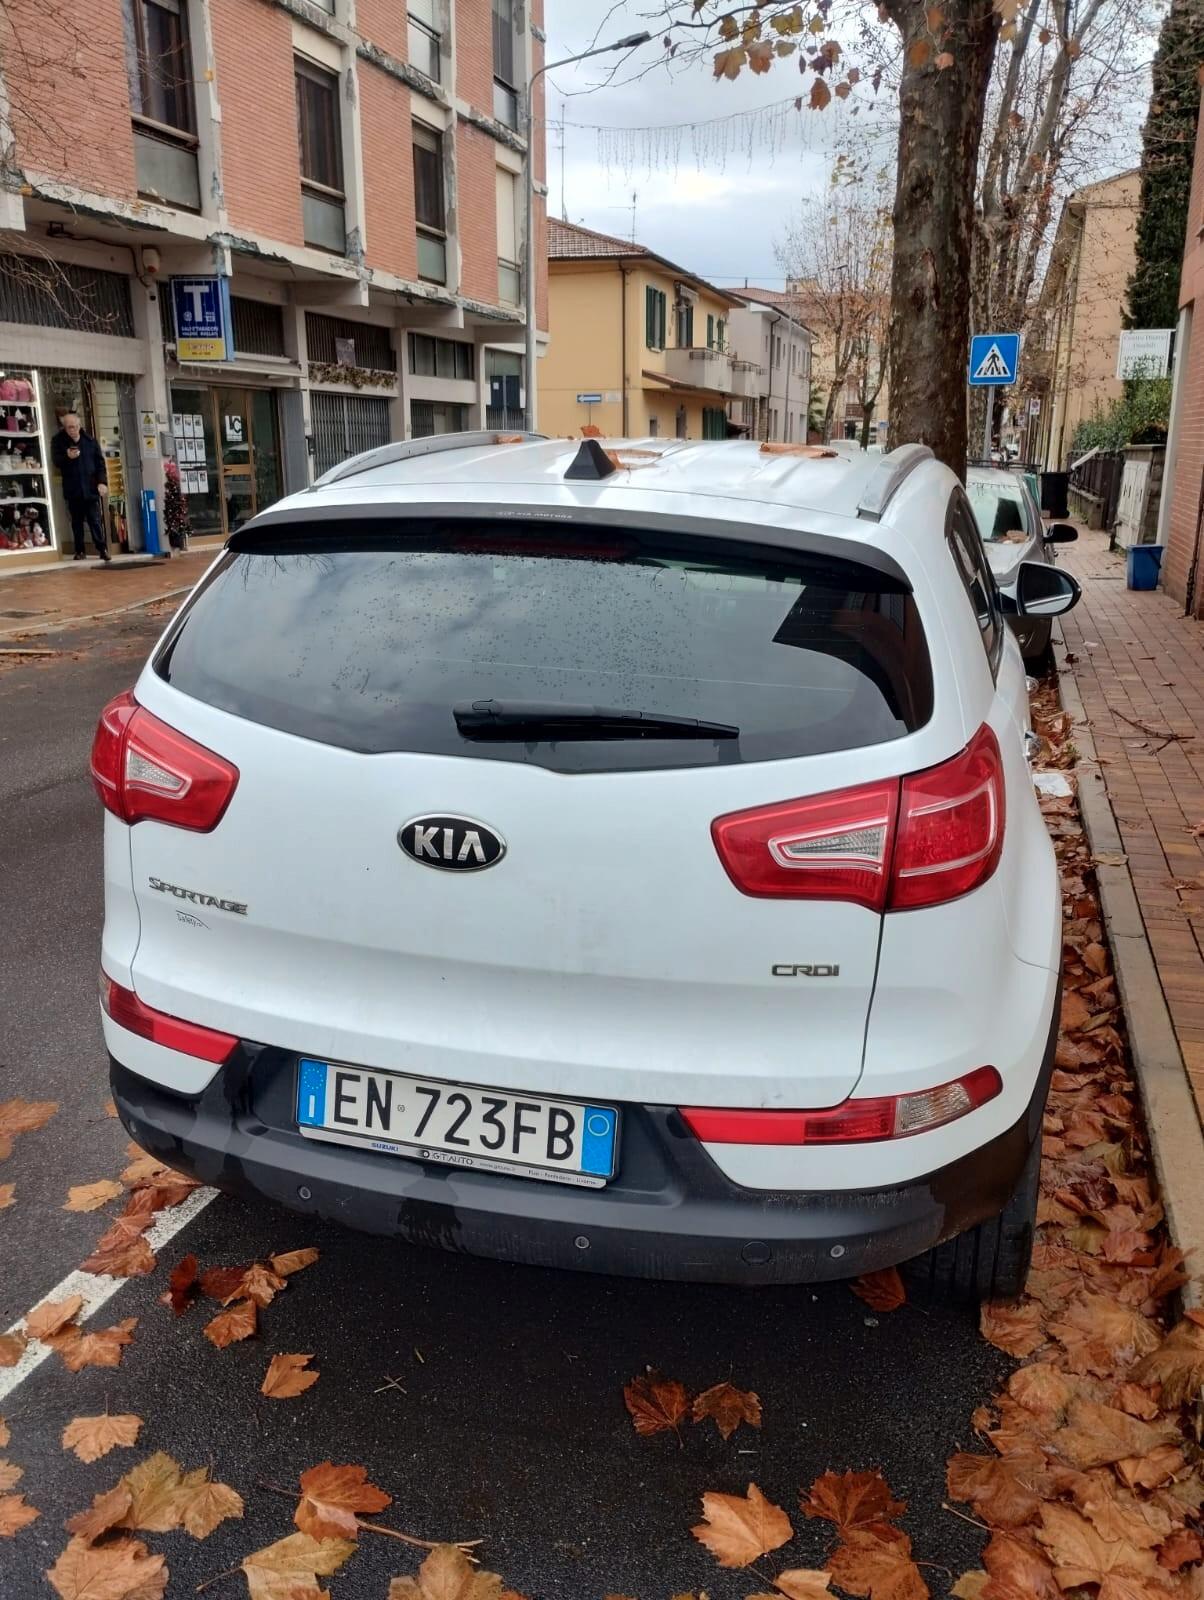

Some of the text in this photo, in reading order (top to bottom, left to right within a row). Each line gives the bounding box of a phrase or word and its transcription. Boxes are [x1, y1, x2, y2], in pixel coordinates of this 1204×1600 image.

[183, 285, 210, 322] T
[414, 825, 487, 862] KIA
[149, 876, 248, 915] SPORTAGE
[333, 1071, 576, 1161] EN 723FB
